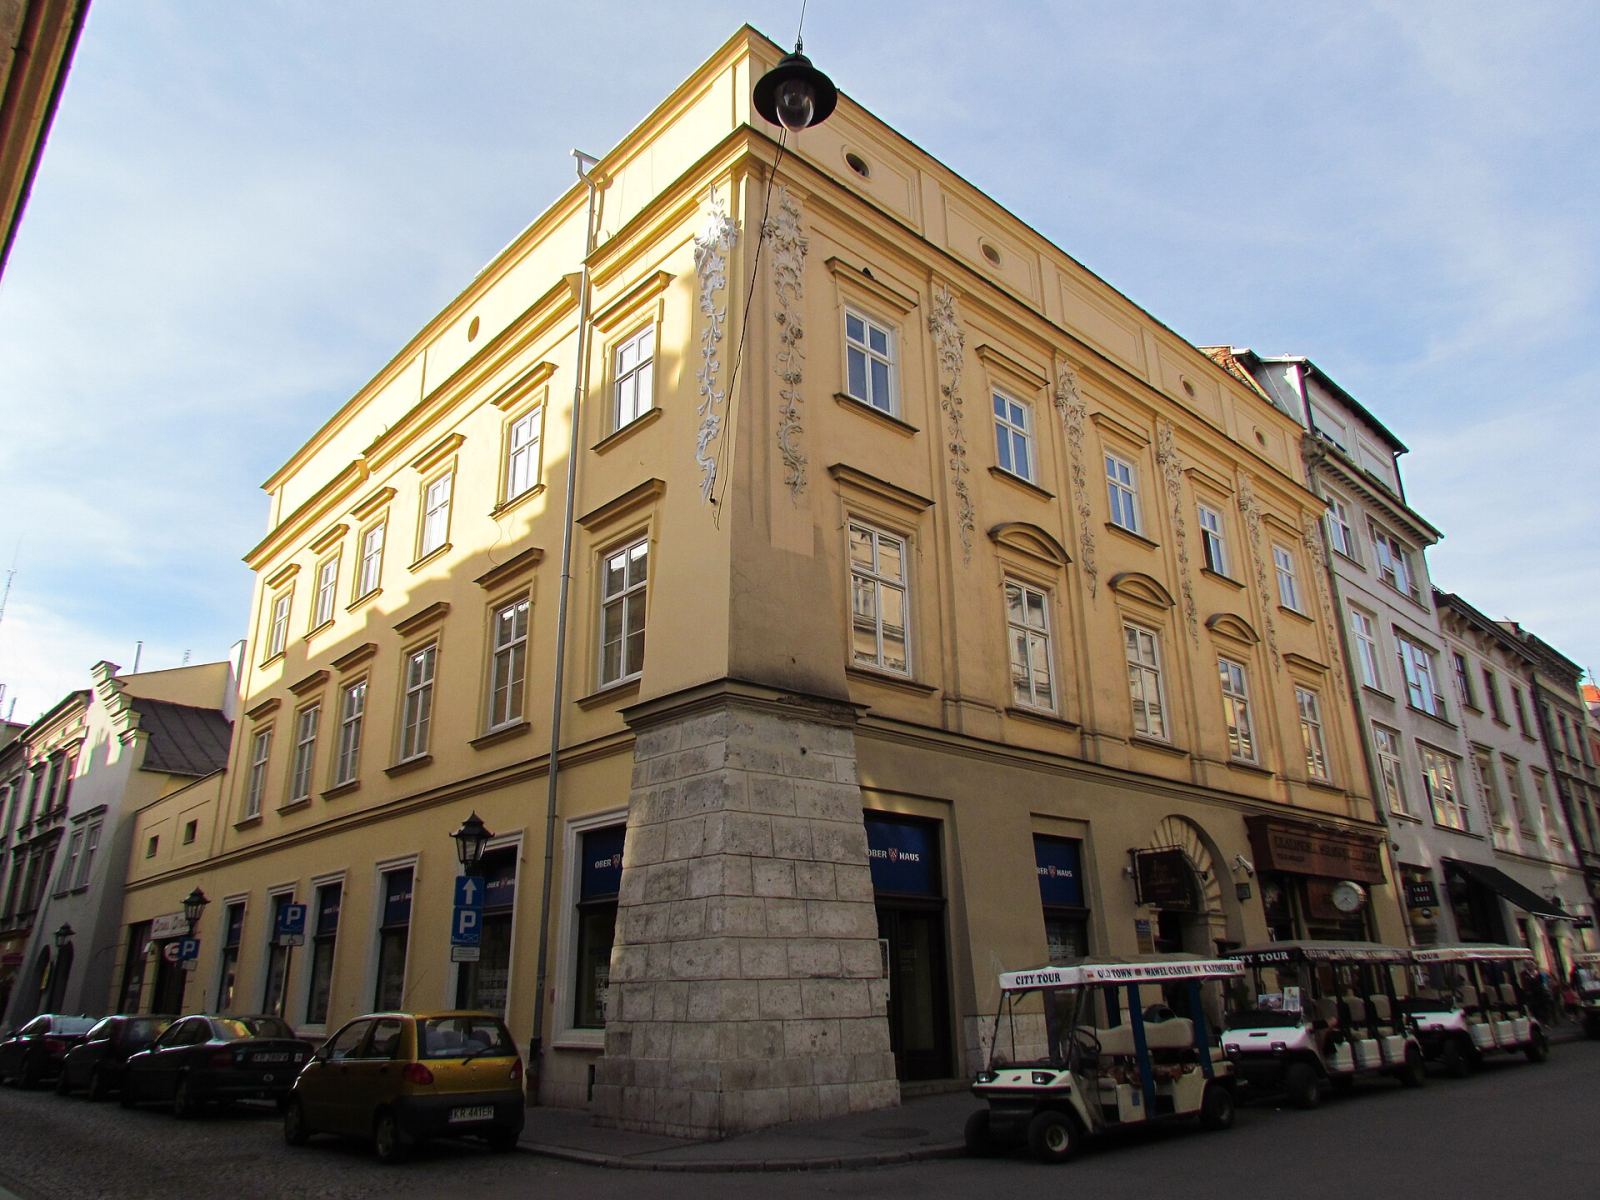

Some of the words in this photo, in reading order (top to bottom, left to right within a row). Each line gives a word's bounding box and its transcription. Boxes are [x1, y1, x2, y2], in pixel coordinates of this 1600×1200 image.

[899, 851, 920, 862] HAUS
[594, 858, 612, 869] OBER
[1056, 868, 1073, 878] HAUS
[285, 906, 302, 926] P
[459, 910, 477, 935] P
[182, 940, 196, 957] P
[1258, 951, 1289, 962] TOUR
[1416, 953, 1440, 961] TOUR
[1111, 968, 1132, 978] TOWN
[1144, 968, 1169, 977] WAWEL
[1169, 966, 1192, 976] CASTLE
[1015, 975, 1034, 985] CITY
[1037, 973, 1061, 983] TOUR
